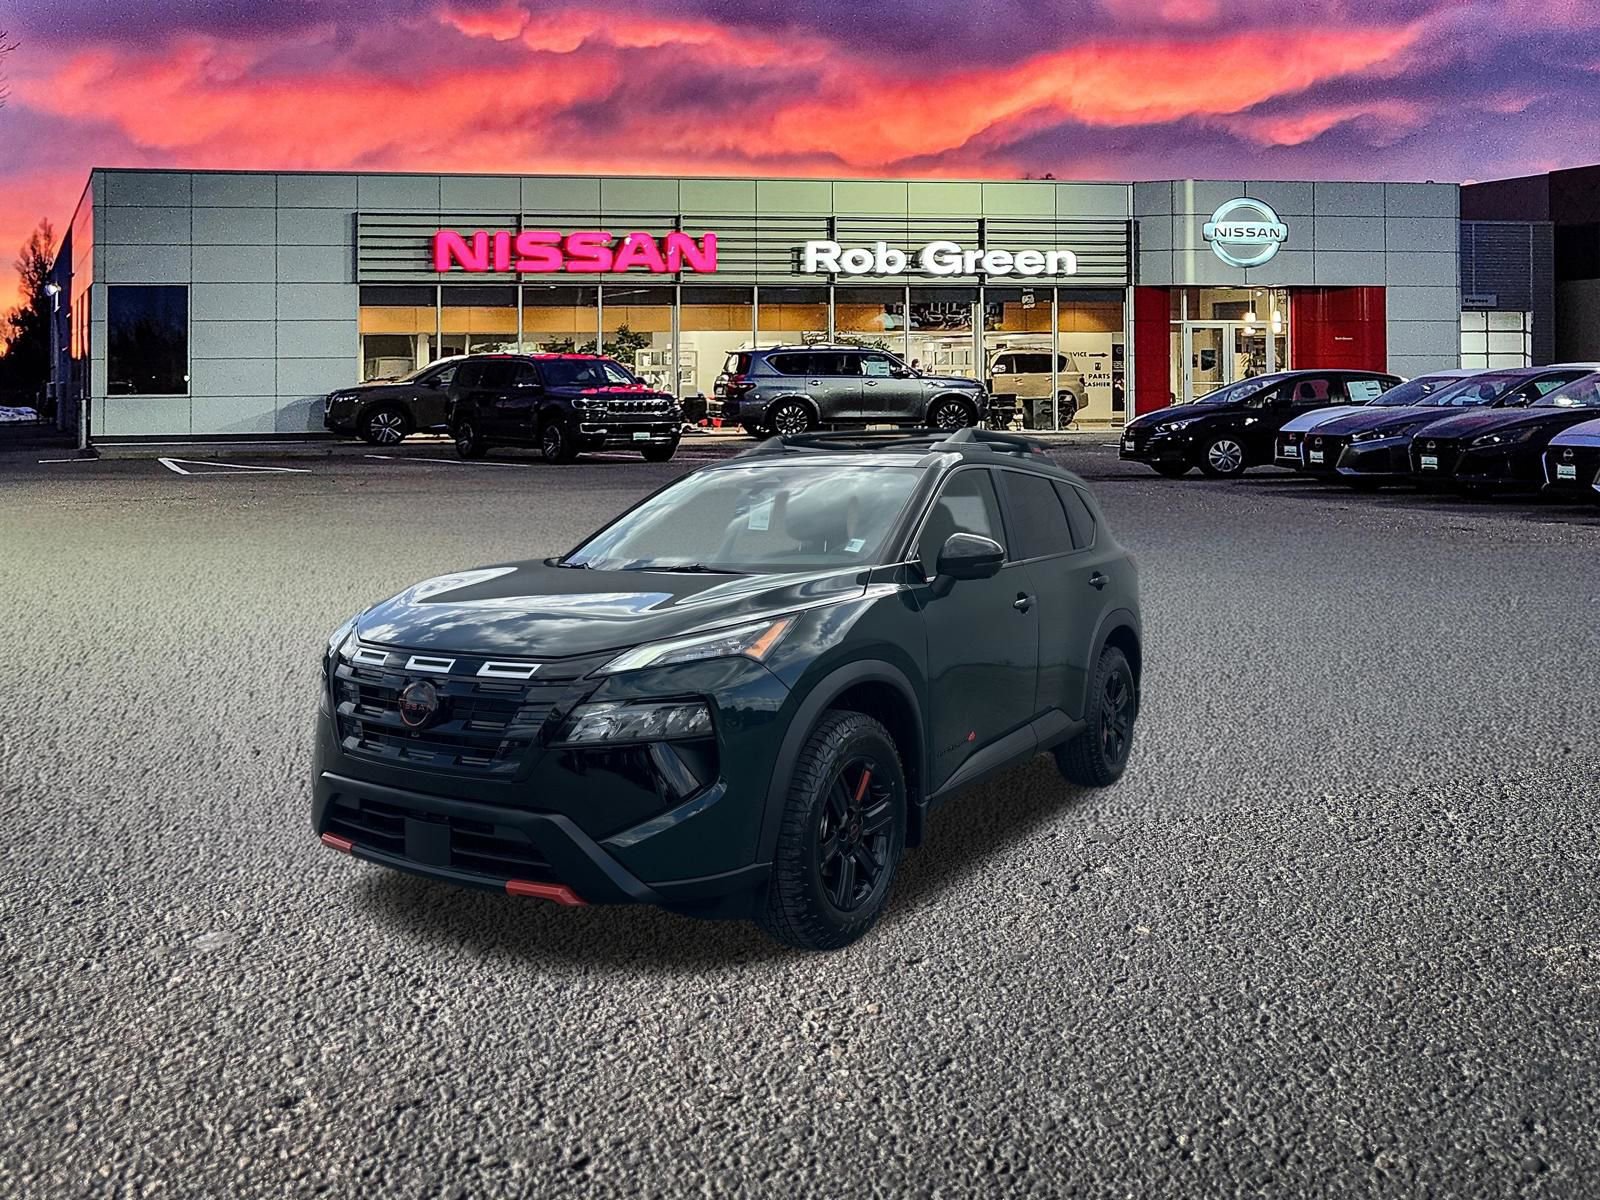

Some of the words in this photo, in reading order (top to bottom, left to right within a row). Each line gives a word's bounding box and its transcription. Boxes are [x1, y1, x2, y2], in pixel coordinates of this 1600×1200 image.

[1214, 227, 1280, 238] NISSAN
[434, 231, 718, 272] NISSAN
[806, 240, 907, 274] Rob
[922, 240, 1078, 275] Green
